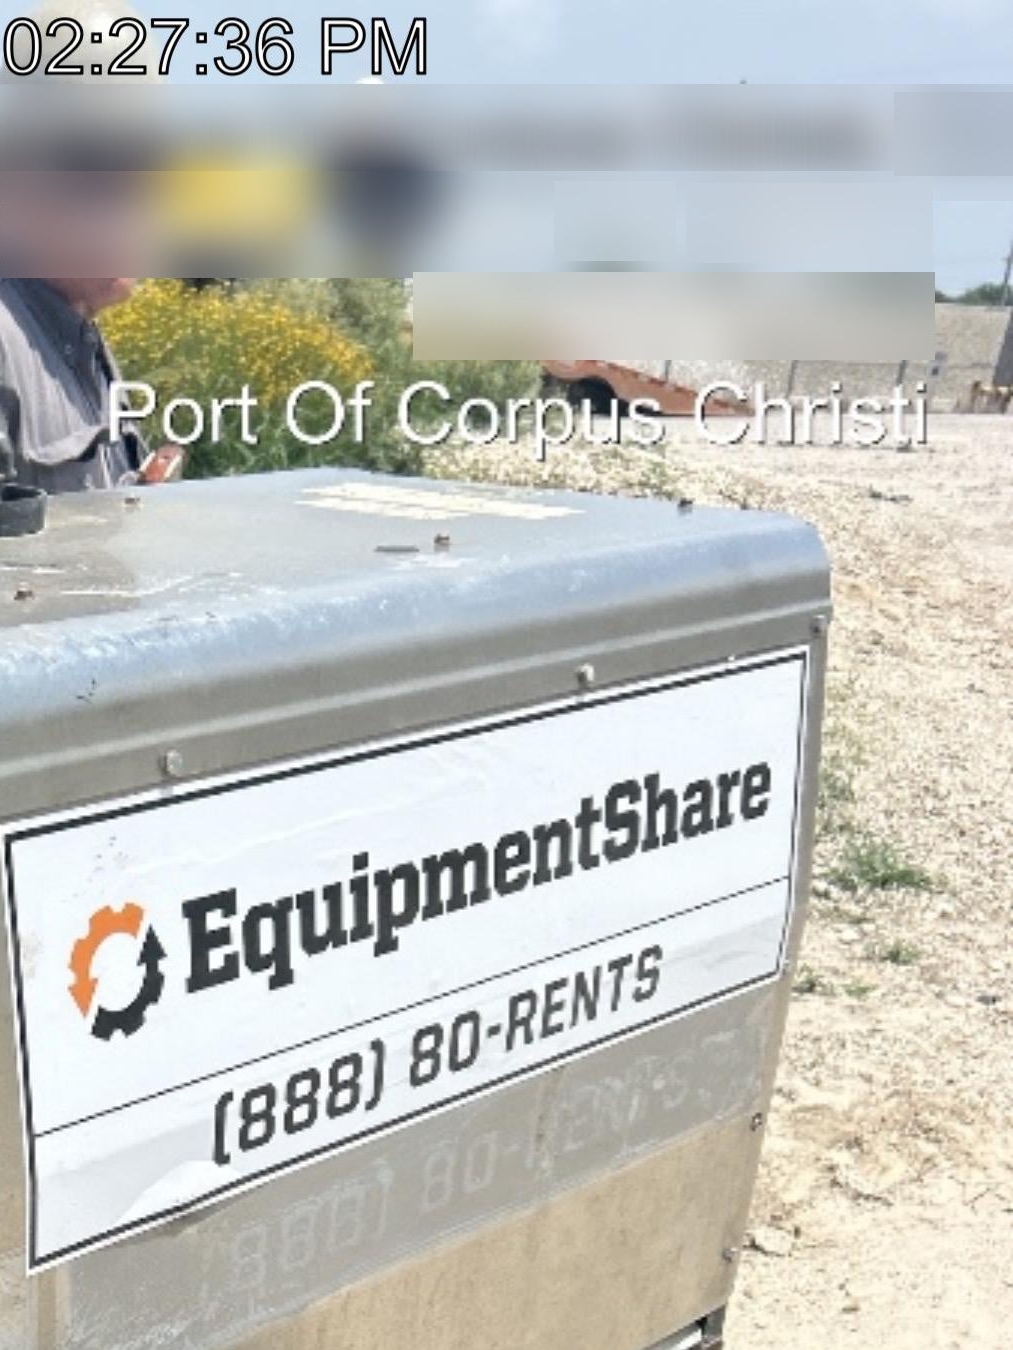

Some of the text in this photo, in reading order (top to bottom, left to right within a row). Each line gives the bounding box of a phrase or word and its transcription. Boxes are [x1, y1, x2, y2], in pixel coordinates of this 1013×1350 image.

[181, 761, 772, 993] EquipmentShare
[212, 944, 663, 1165] (888) 80-RENTS
